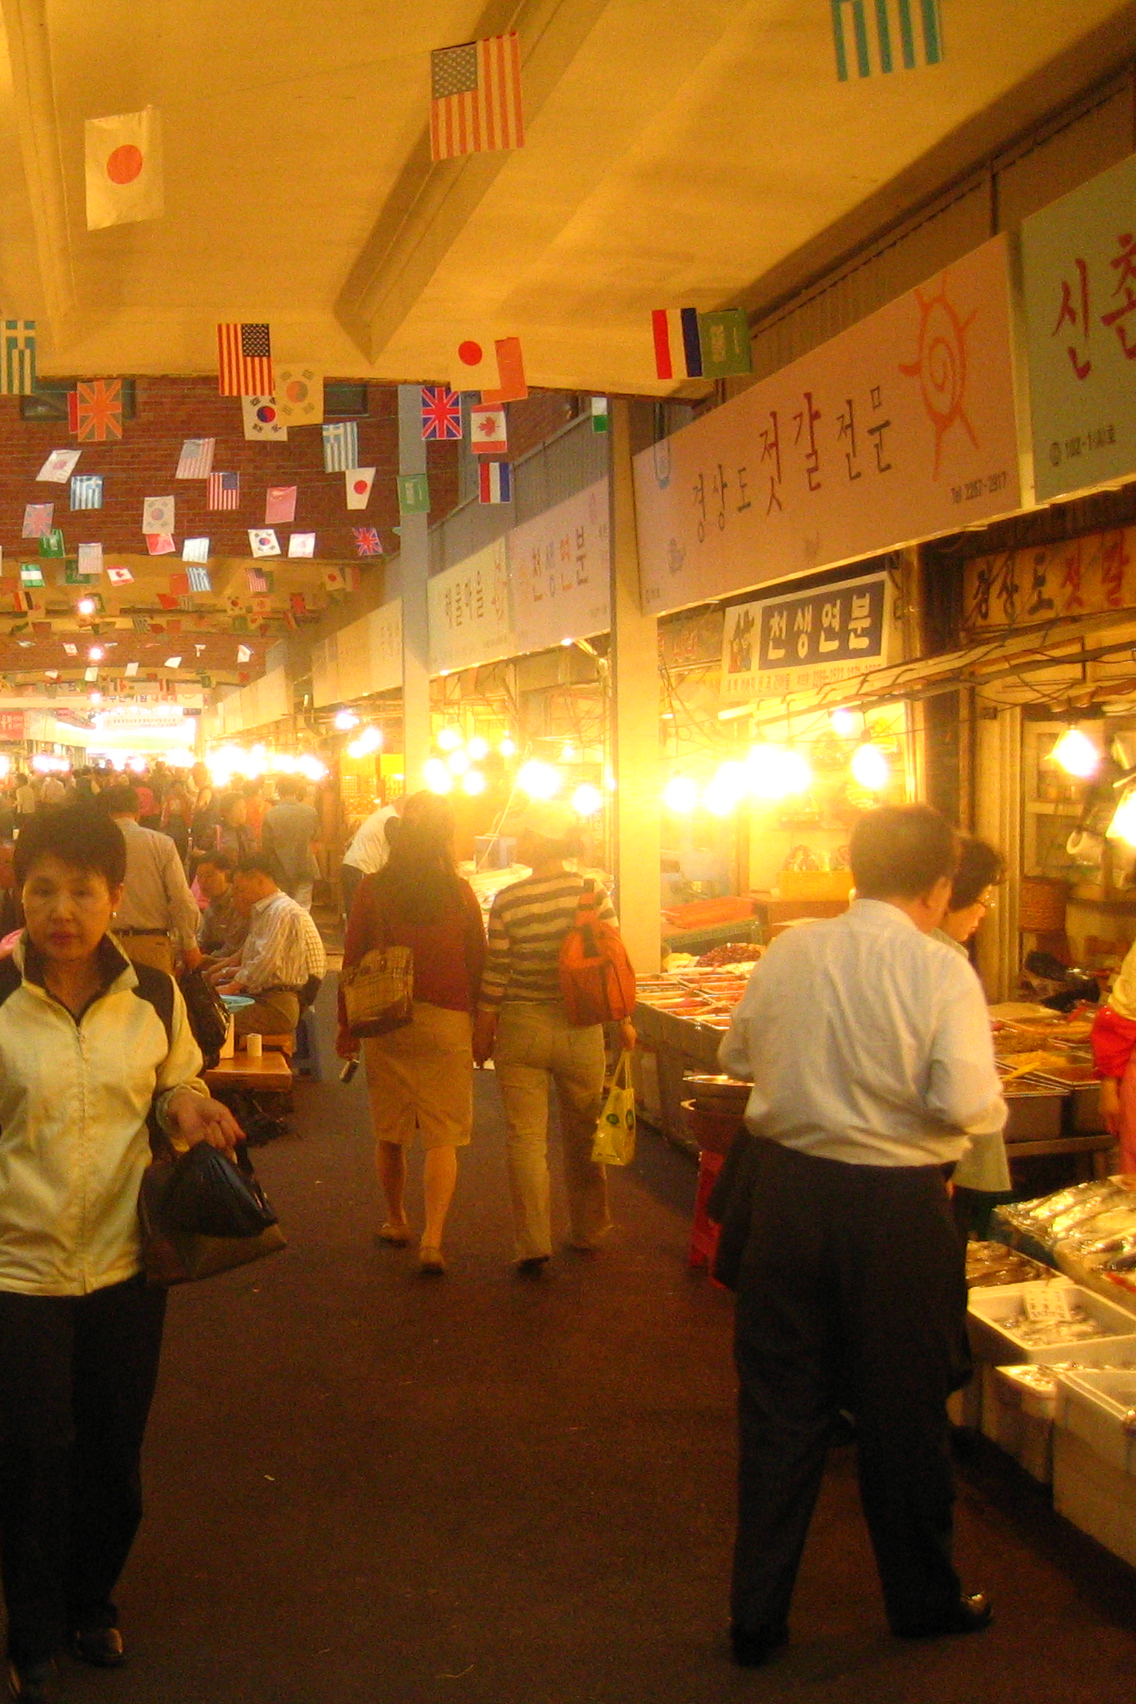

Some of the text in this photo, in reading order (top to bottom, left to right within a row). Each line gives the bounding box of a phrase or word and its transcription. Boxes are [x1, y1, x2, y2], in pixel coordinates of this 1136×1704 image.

[759, 392, 821, 516] 젓갈
[836, 386, 892, 481] 전문
[767, 592, 872, 660] 천생연분
